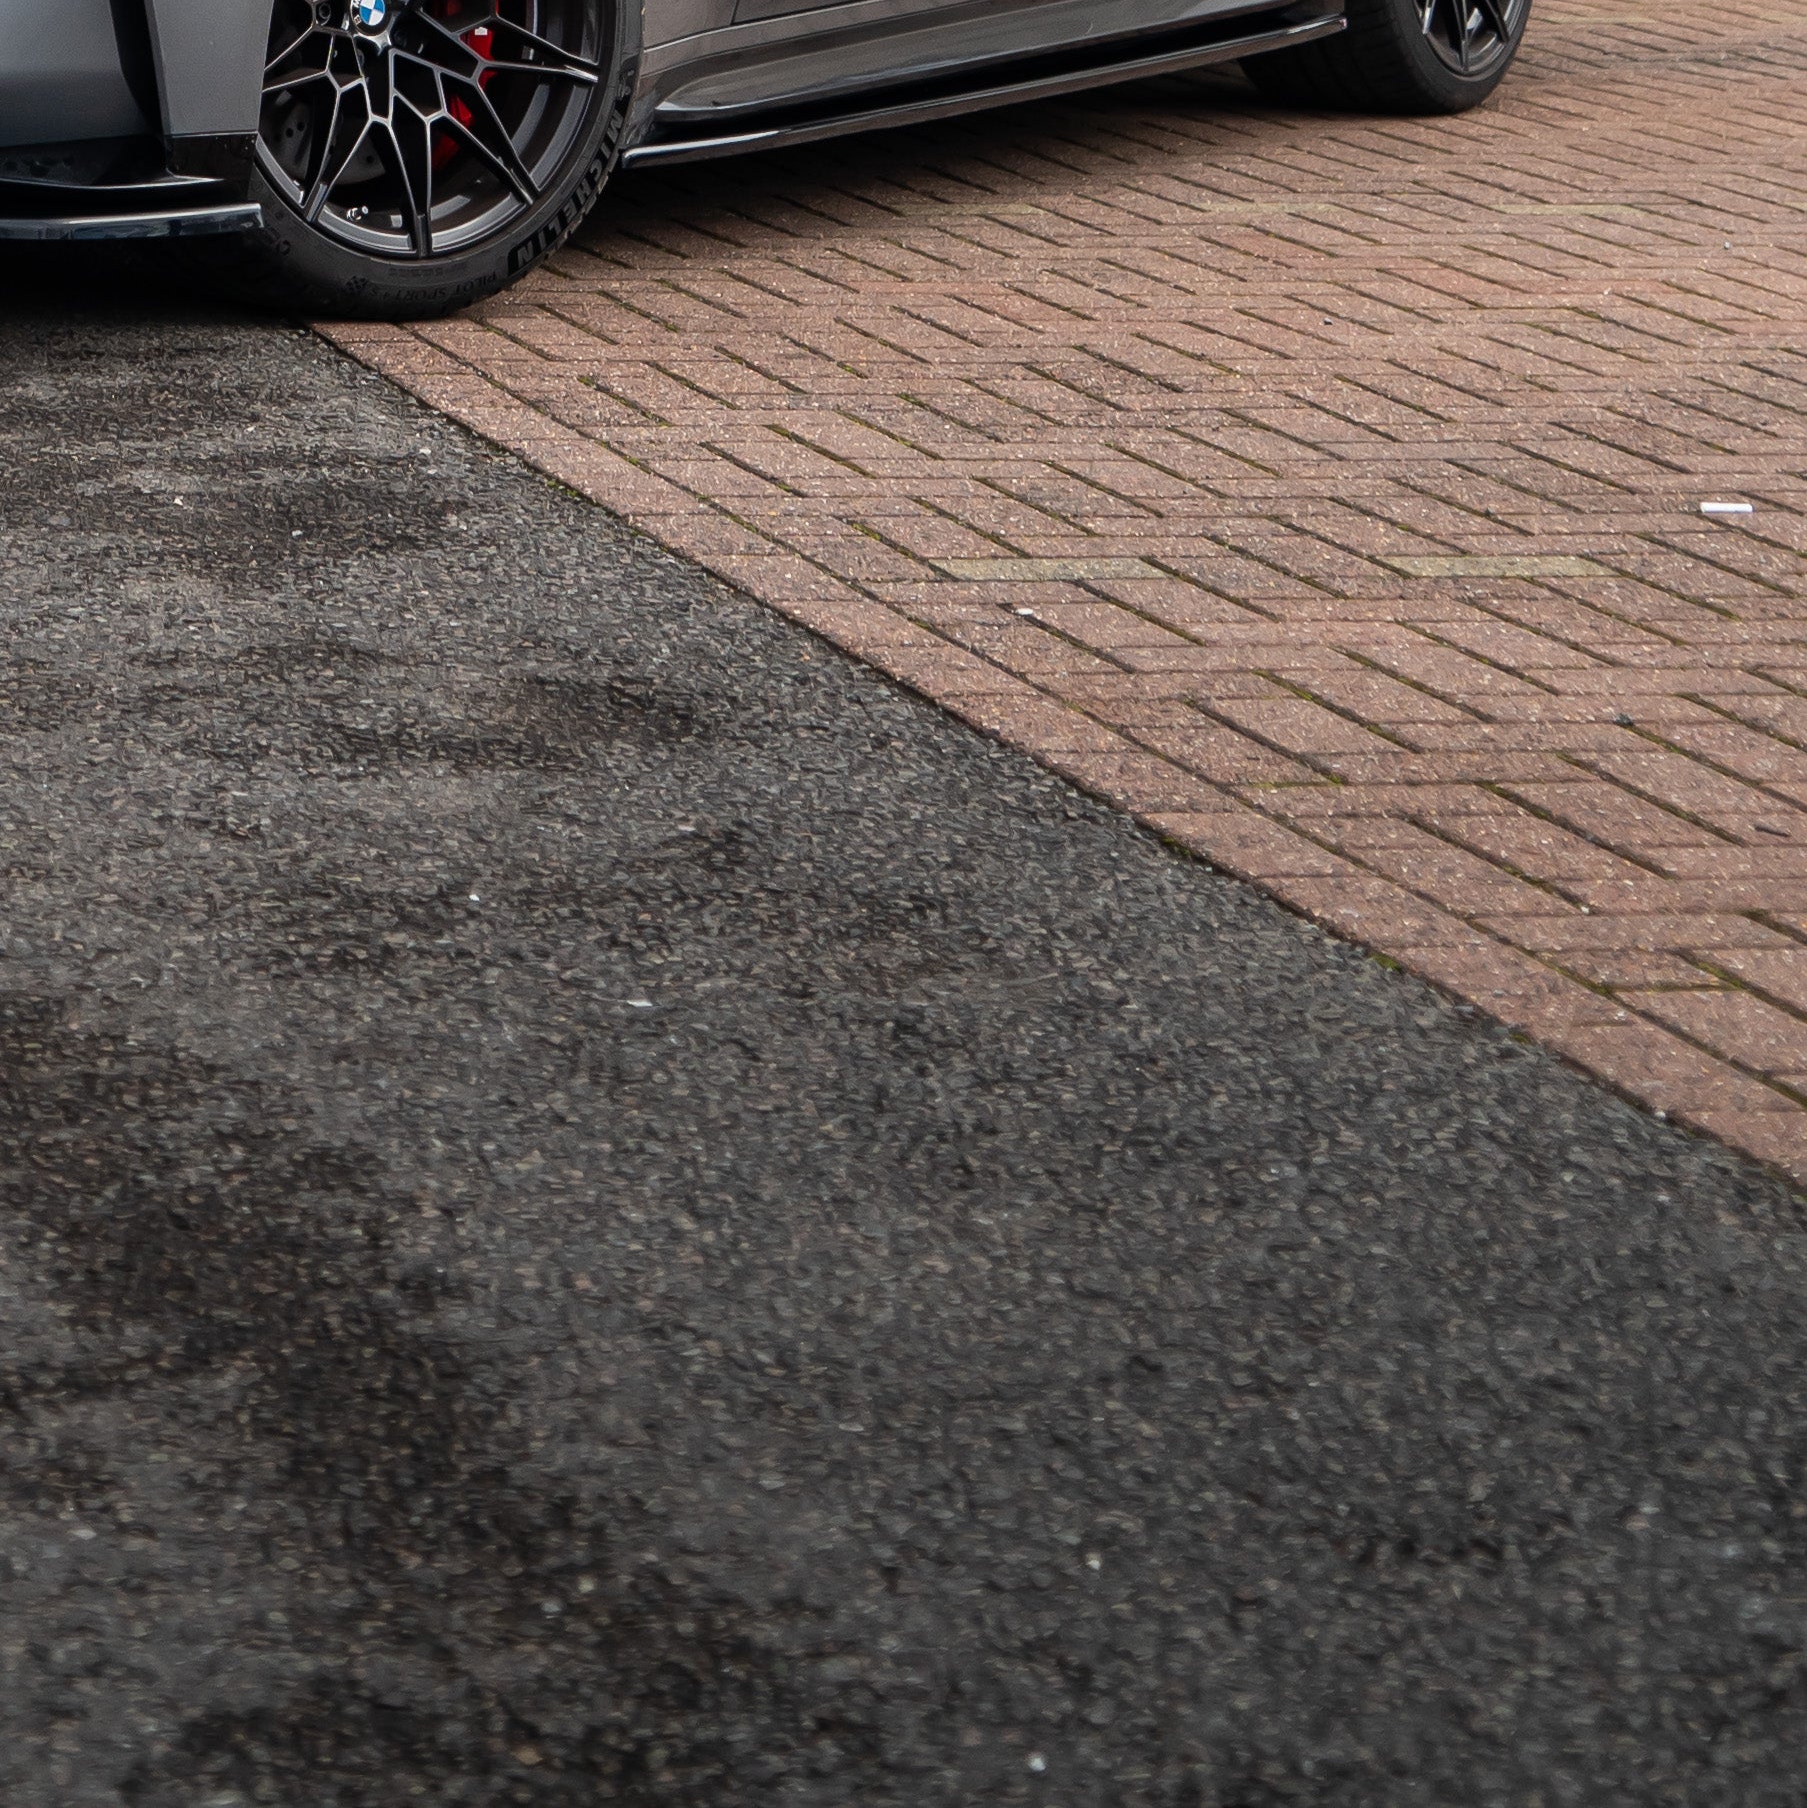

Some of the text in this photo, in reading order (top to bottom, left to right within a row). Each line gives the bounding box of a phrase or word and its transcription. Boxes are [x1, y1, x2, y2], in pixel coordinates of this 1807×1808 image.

[517, 110, 624, 267] MICHELIN
[395, 287, 447, 301] SPORT
[454, 272, 498, 295] PILOT
